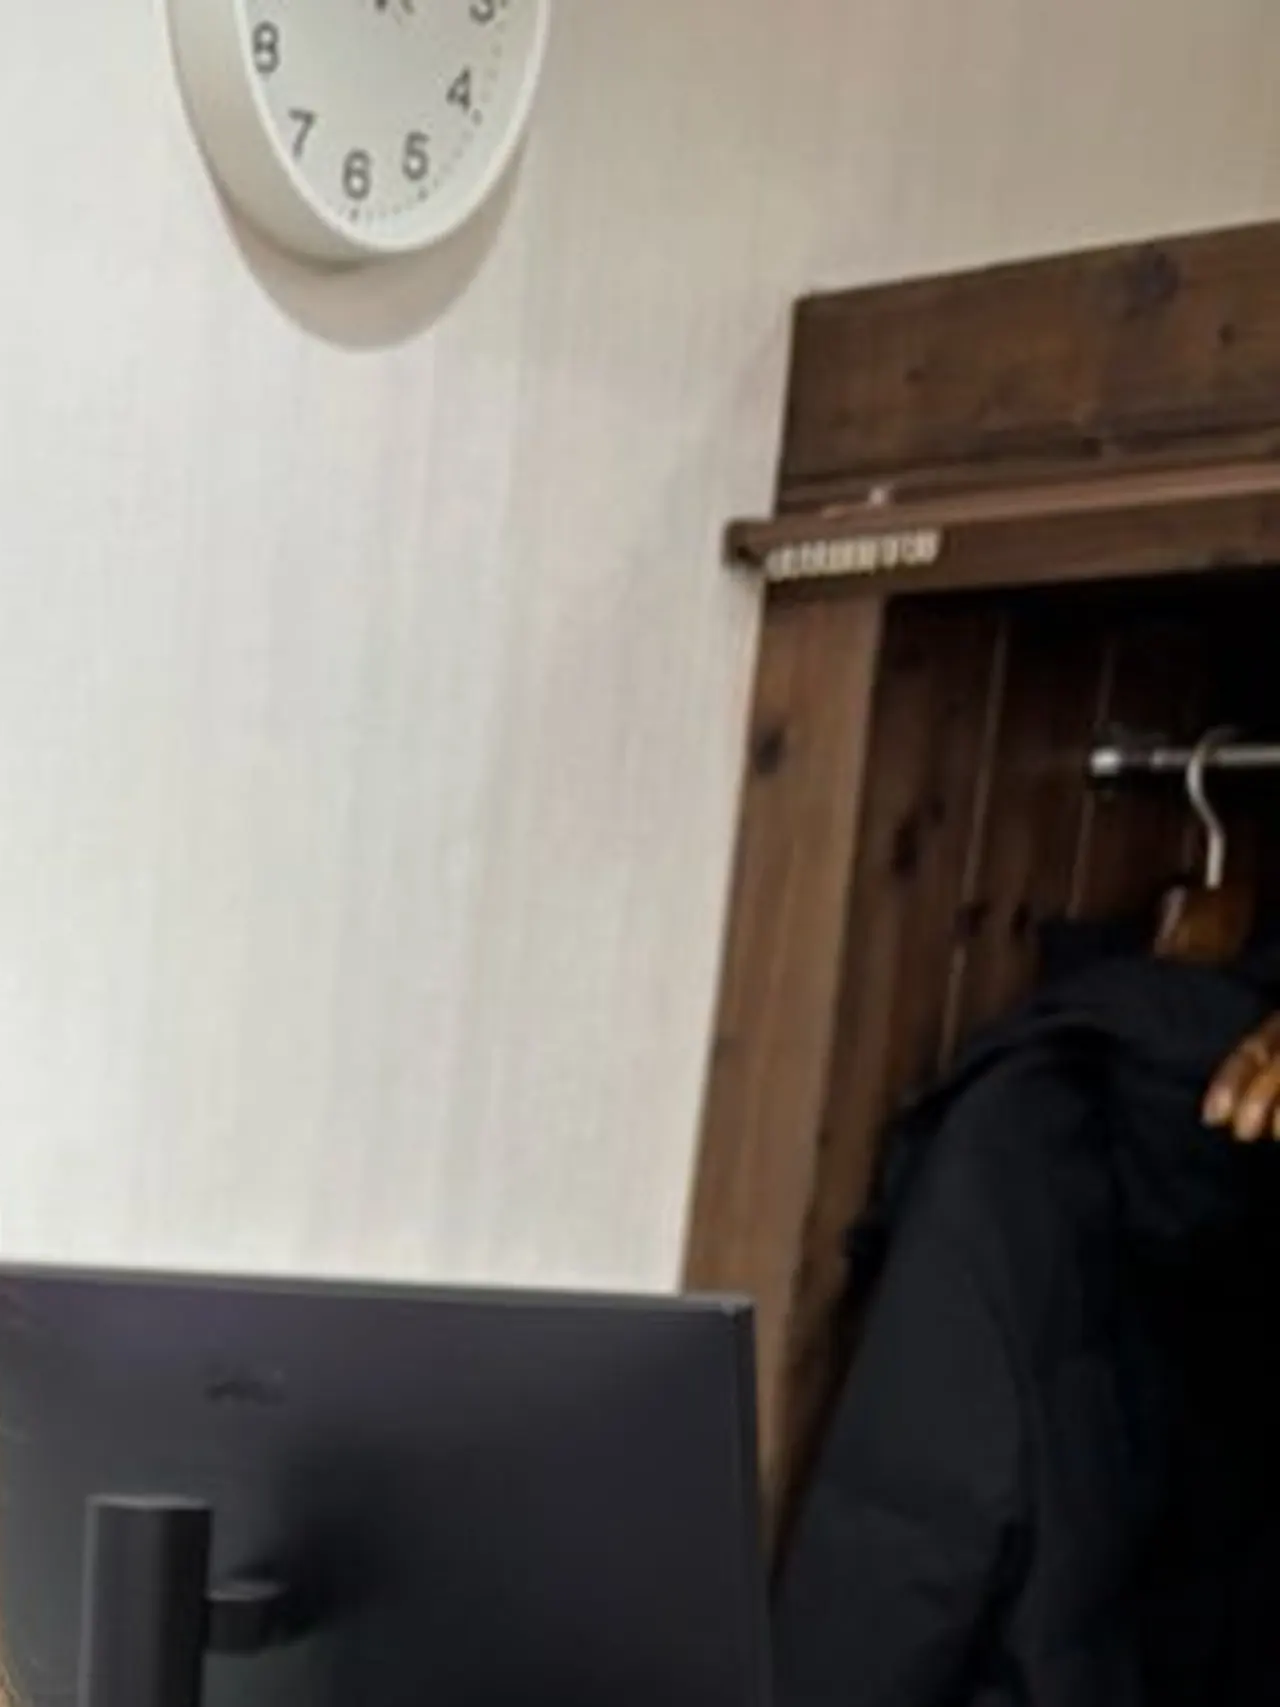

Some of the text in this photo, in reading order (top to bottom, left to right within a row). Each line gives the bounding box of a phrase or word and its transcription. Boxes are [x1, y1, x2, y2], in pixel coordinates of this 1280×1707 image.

[252, 21, 280, 74] 8
[446, 66, 472, 114] 4
[290, 109, 316, 157] 7
[403, 132, 431, 181] 5
[342, 149, 372, 200] 6
